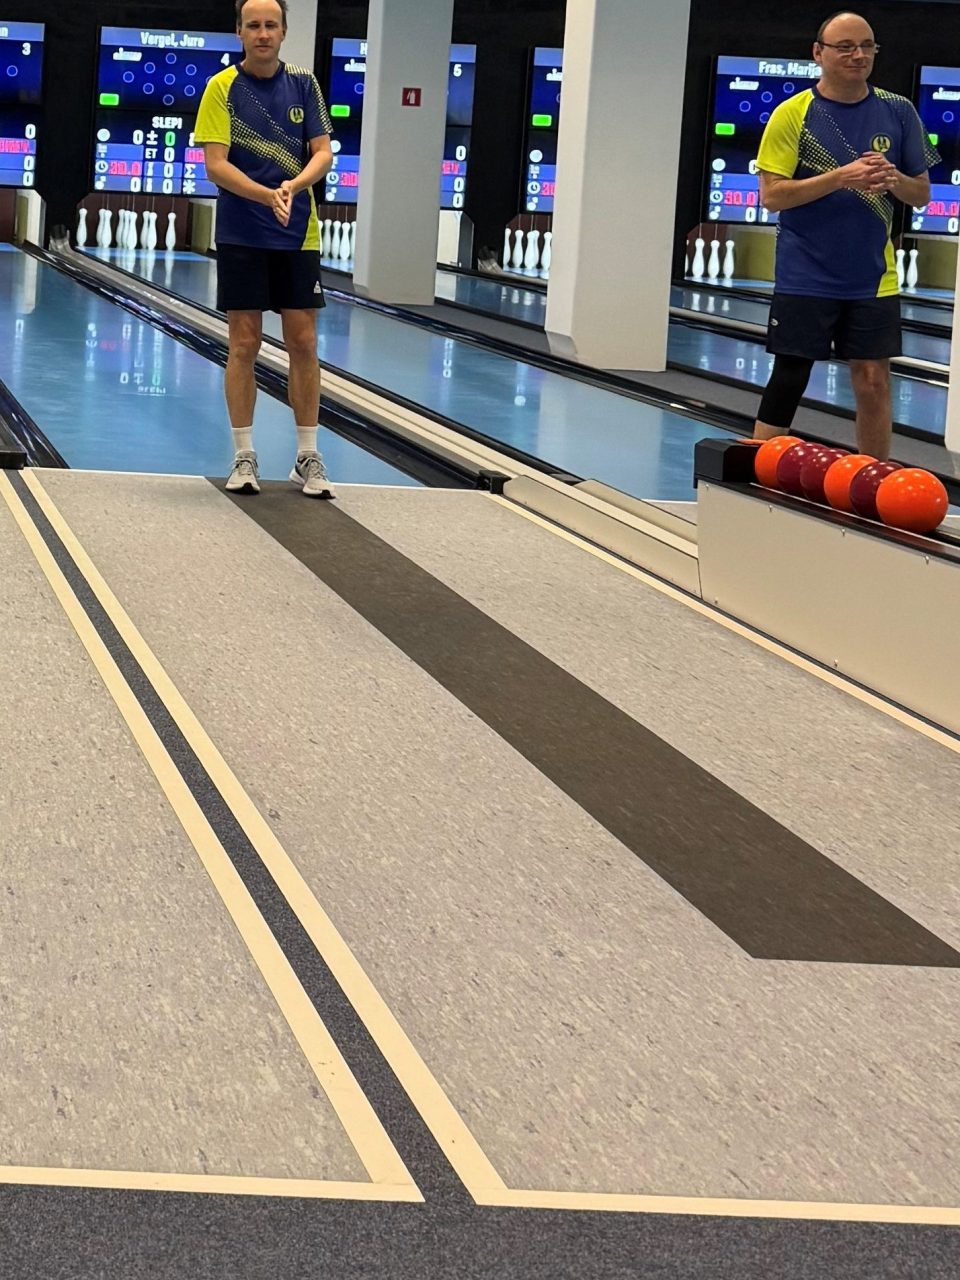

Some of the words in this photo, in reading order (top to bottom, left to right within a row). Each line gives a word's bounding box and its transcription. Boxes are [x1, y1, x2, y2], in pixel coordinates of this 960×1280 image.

[21, 42, 32, 56] 3
[220, 53, 230, 66] 4
[452, 64, 463, 78] 5
[151, 116, 183, 130] SLEPI
